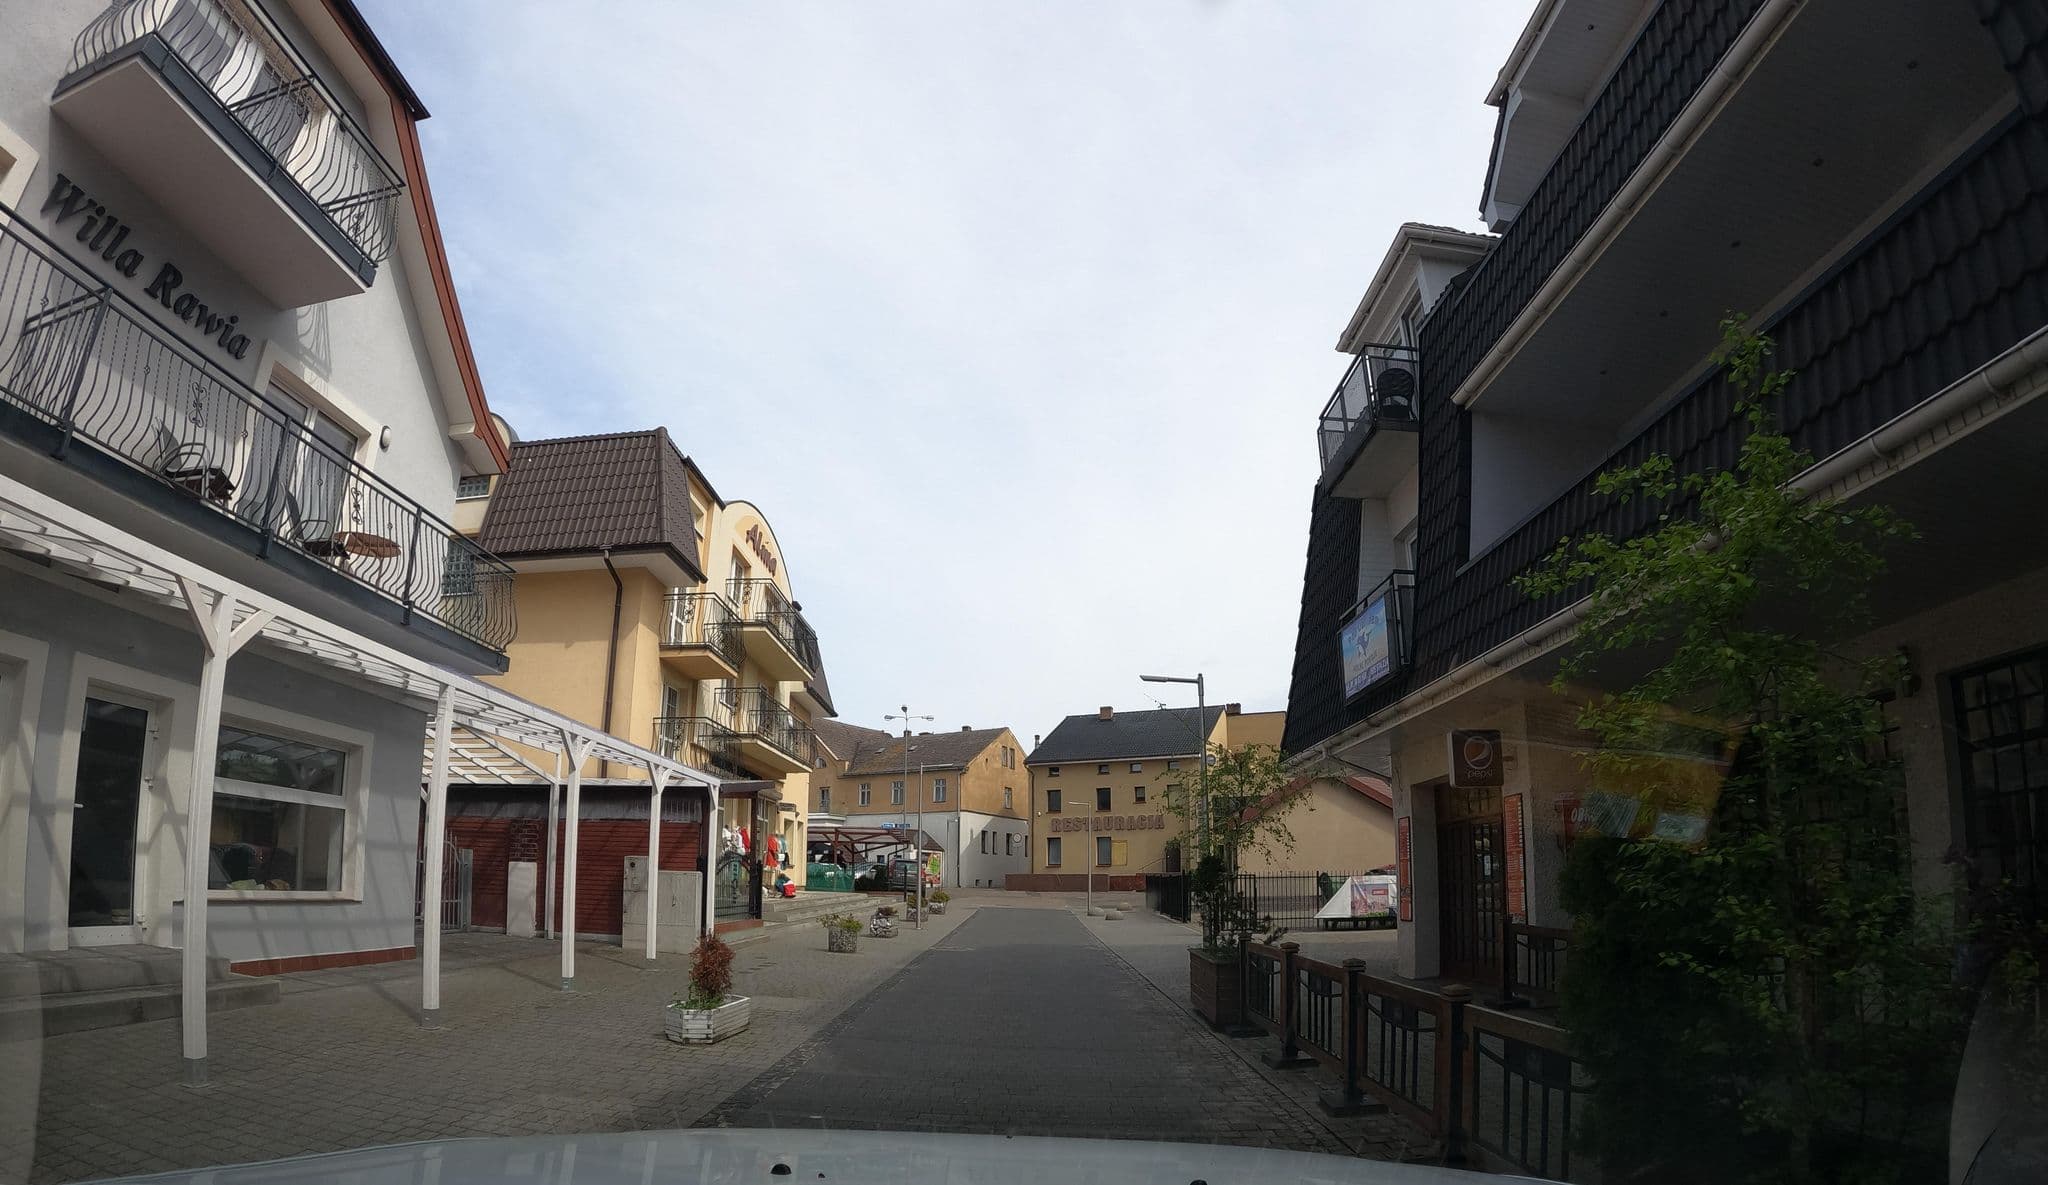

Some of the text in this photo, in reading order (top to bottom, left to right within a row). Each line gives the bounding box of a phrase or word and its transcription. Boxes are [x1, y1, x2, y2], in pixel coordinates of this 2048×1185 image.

[40, 173, 252, 360] Willa Rawia
[745, 524, 777, 577] Alina
